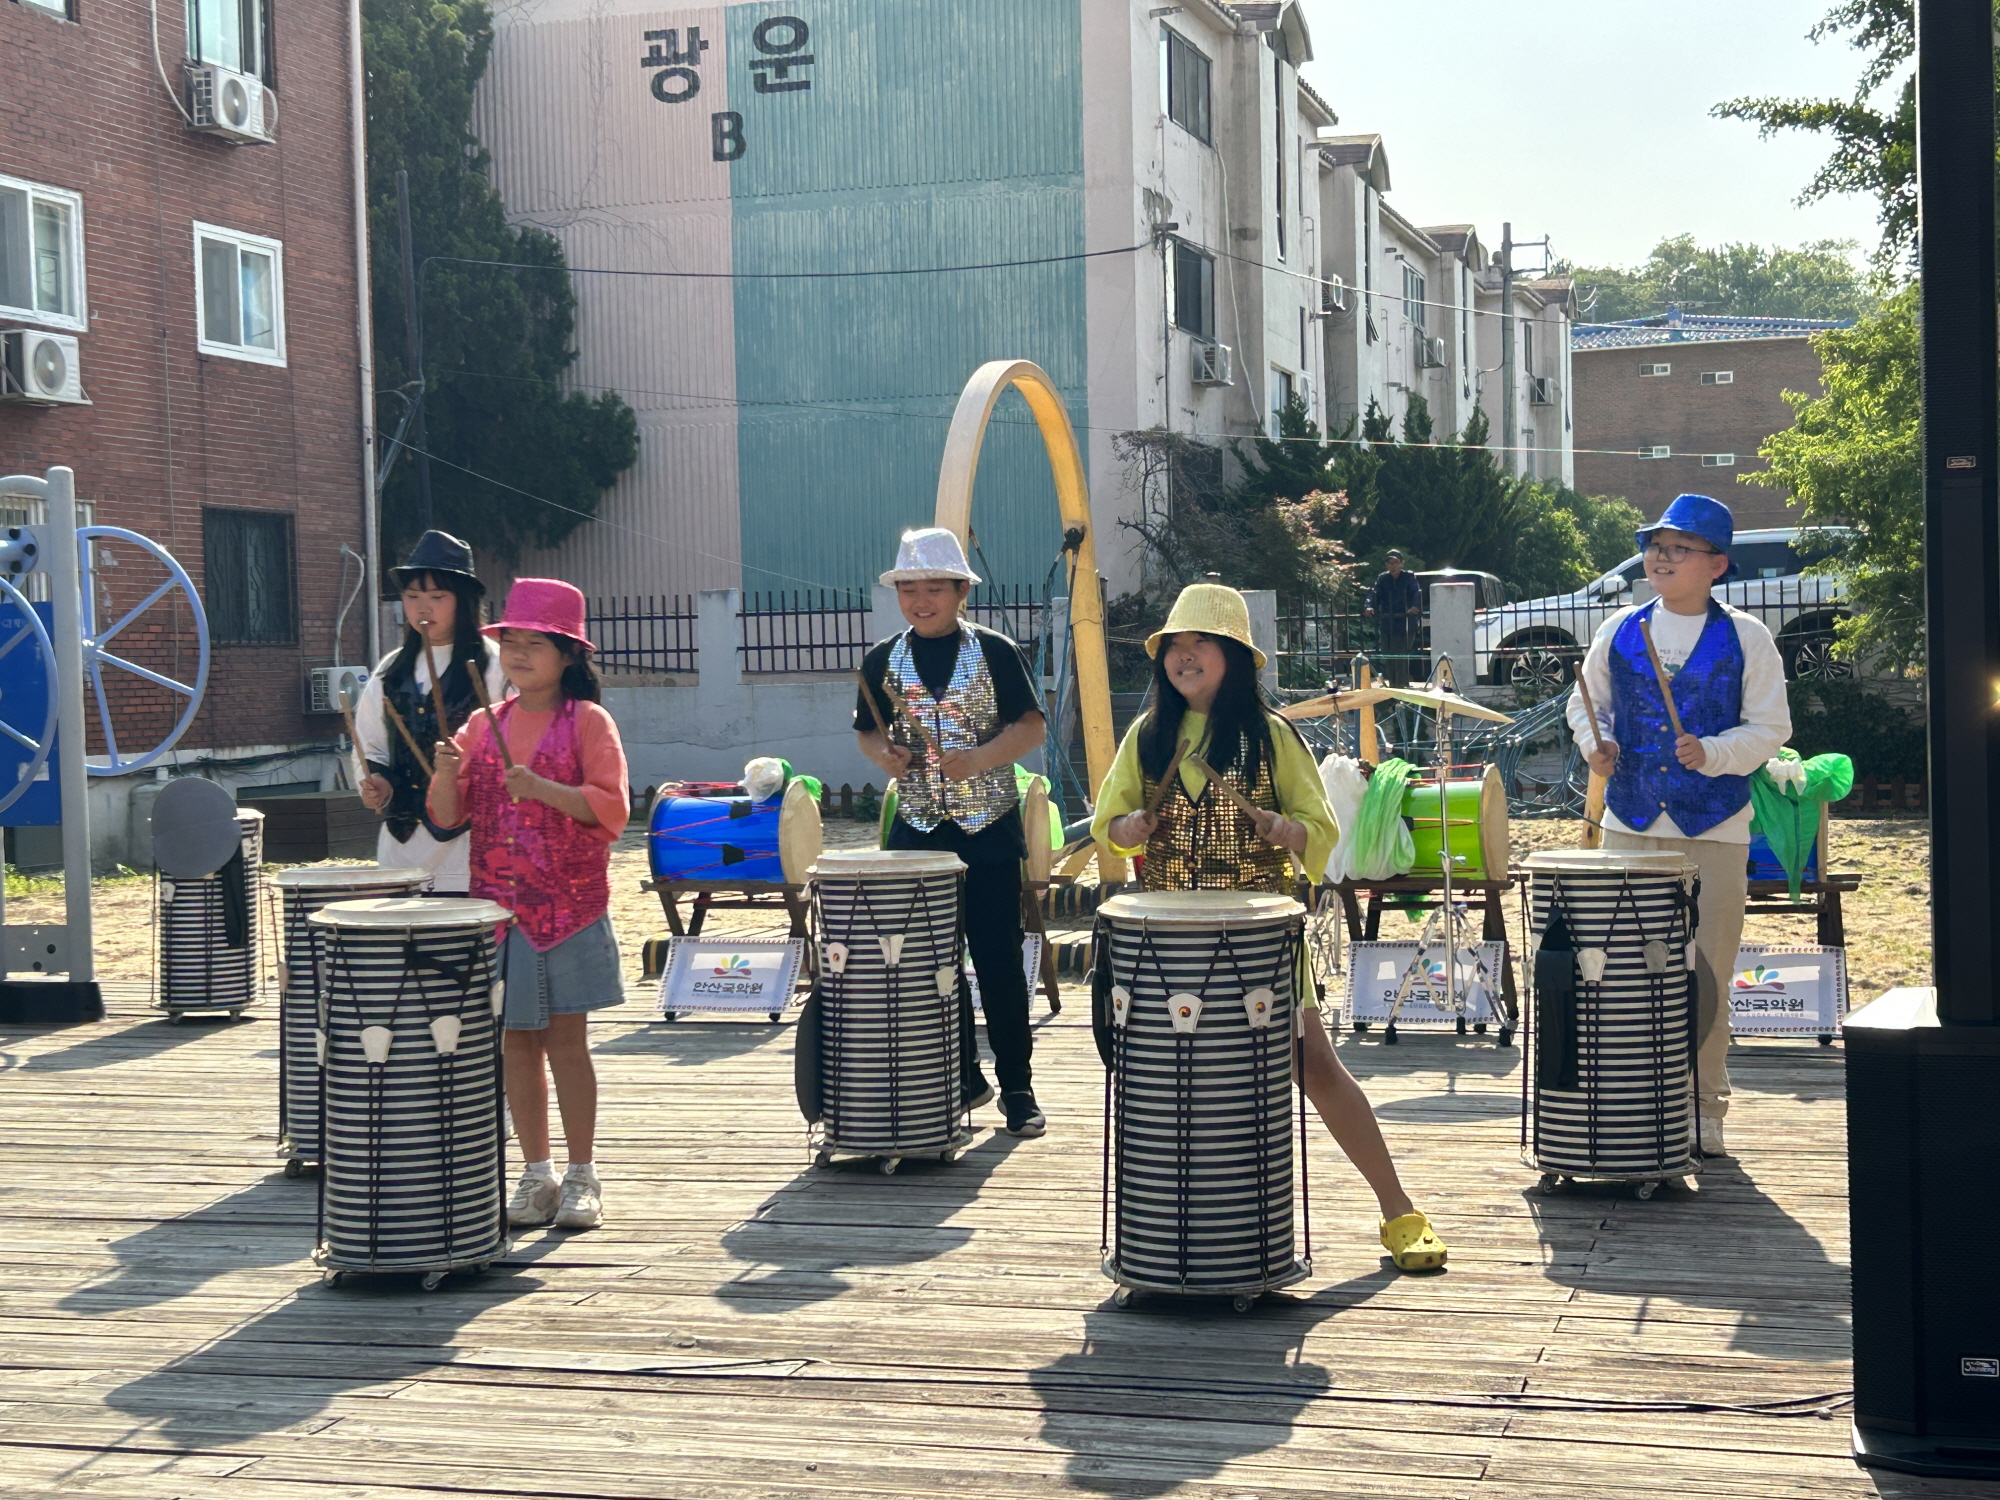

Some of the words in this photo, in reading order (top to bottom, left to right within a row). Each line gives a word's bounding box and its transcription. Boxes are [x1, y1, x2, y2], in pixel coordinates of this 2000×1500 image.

[711, 111, 747, 162] B
[692, 981, 764, 995] 안산국악원
[1731, 998, 1804, 1012] 산국악원
